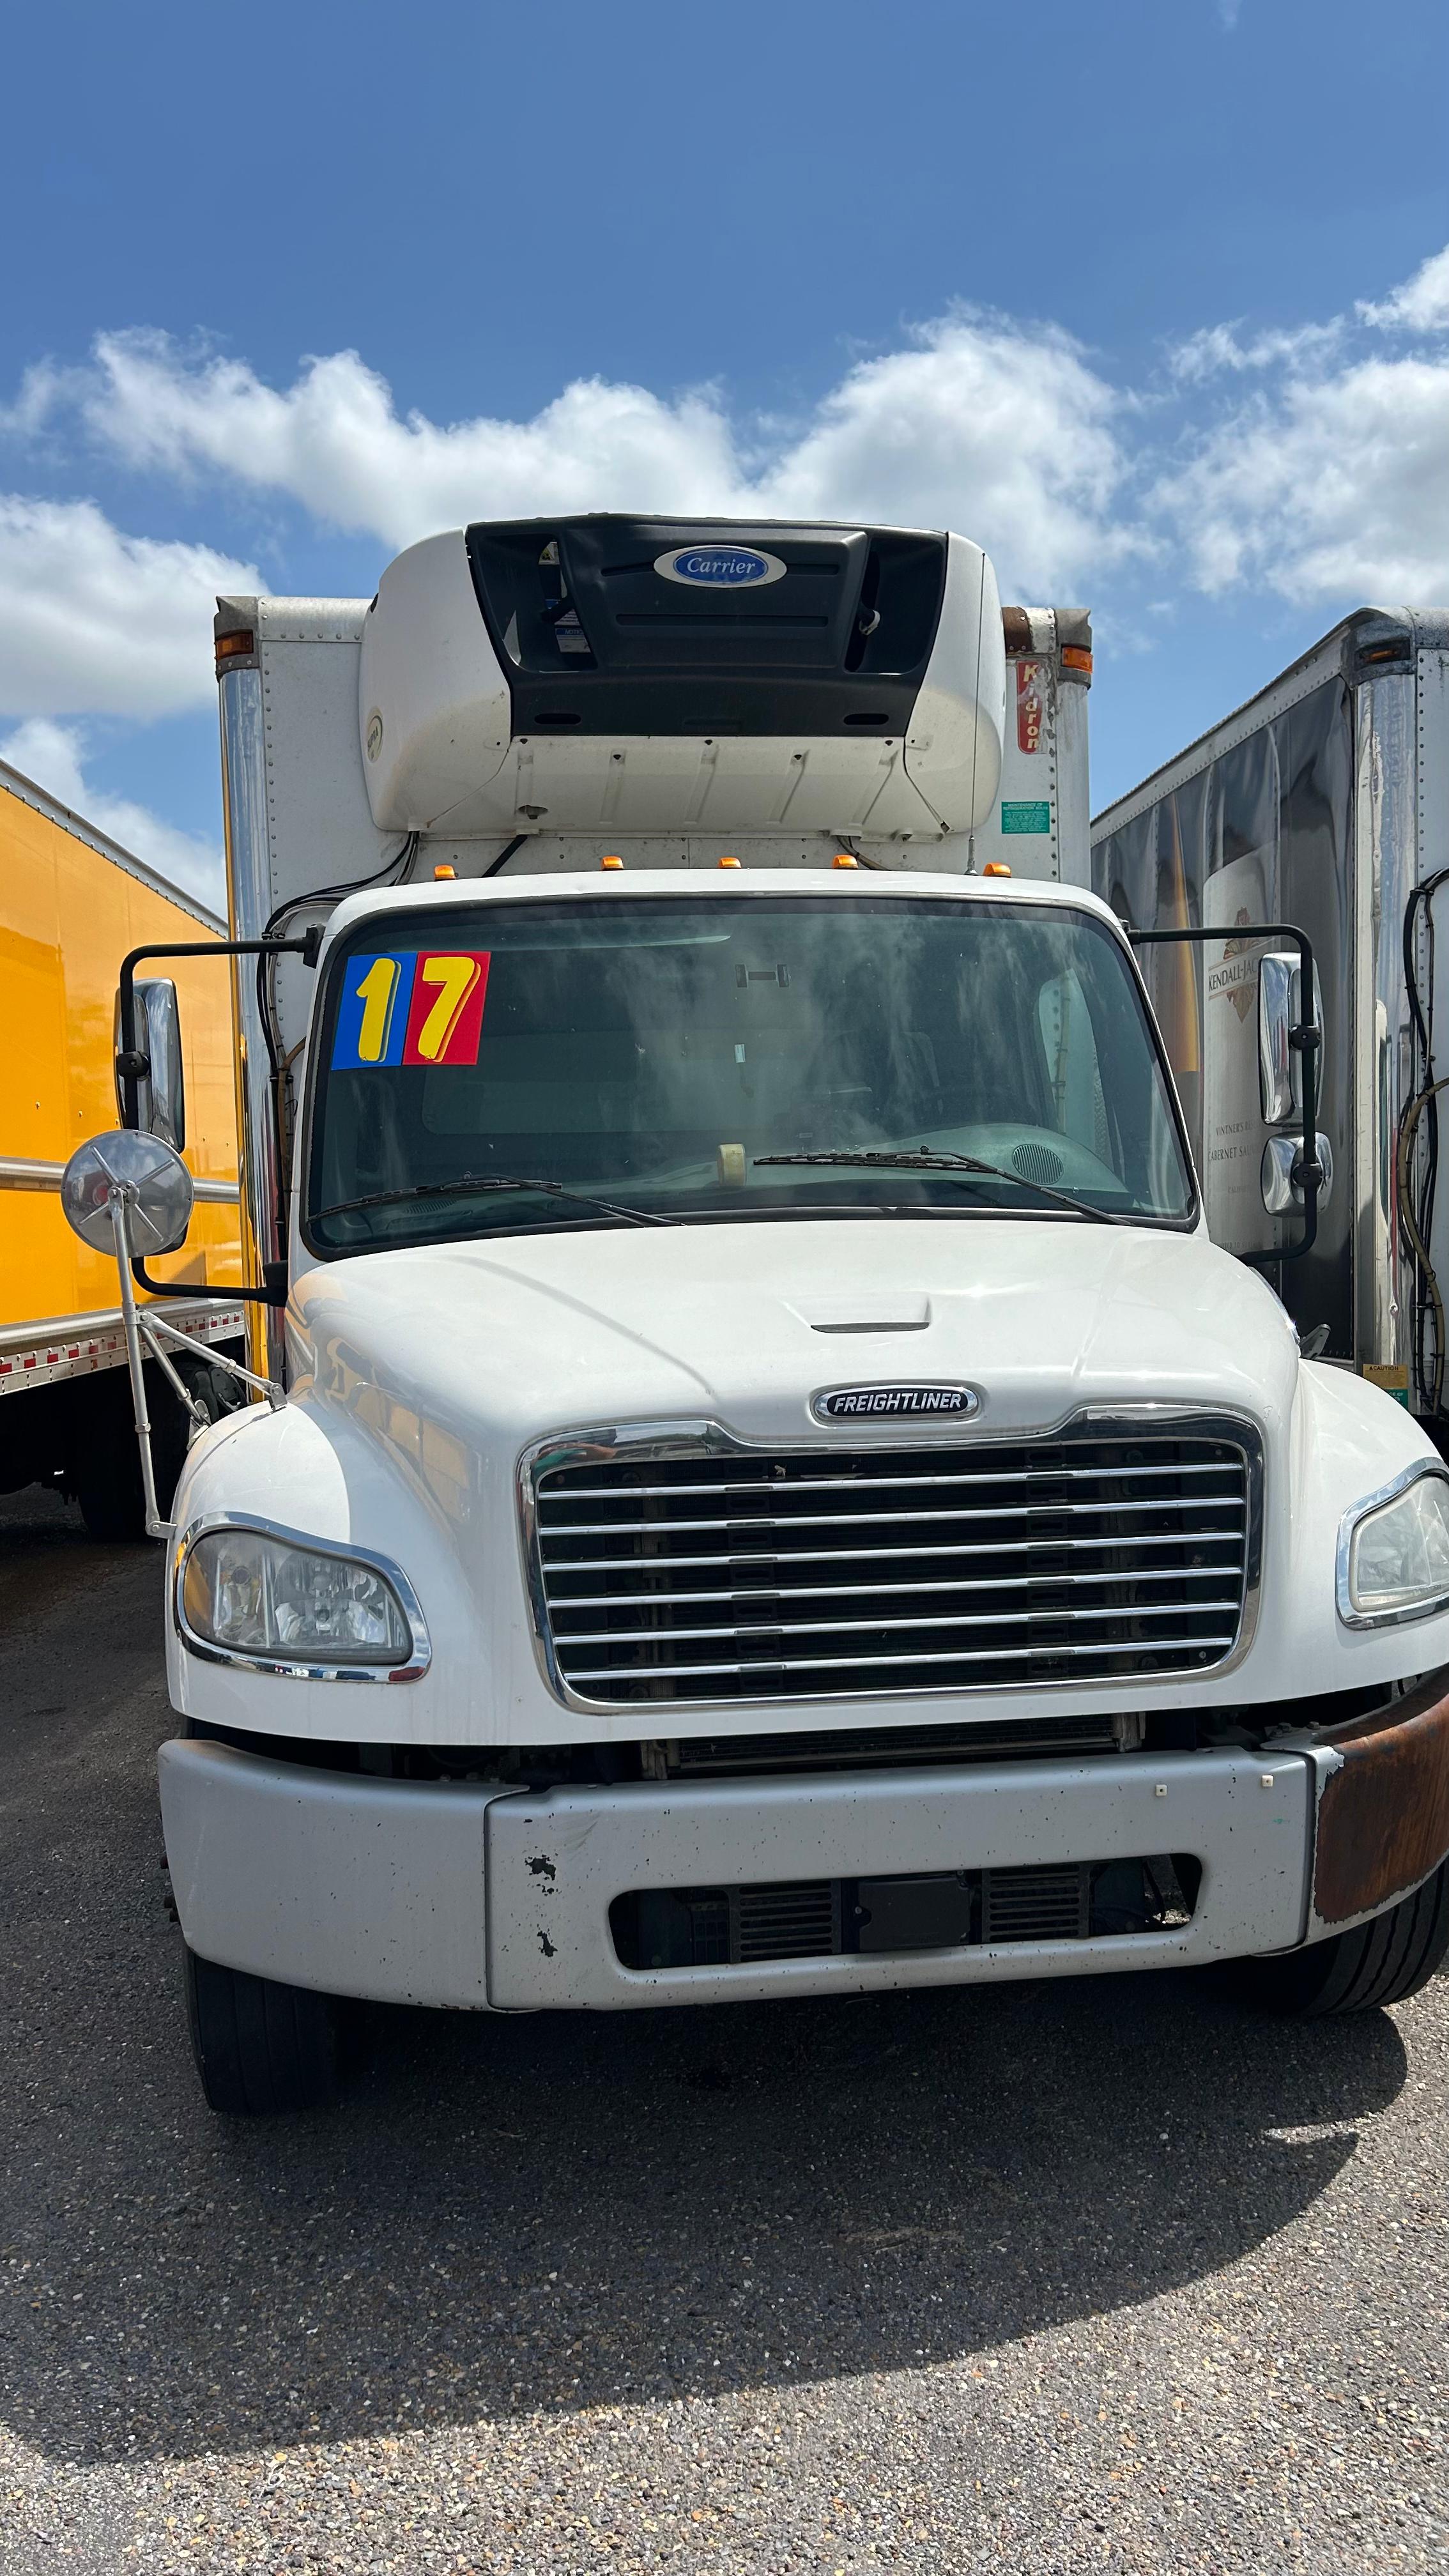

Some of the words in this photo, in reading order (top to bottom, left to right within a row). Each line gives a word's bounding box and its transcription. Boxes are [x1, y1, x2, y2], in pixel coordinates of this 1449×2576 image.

[687, 557, 756, 574] Carrier
[356, 956, 481, 1062] 17
[1208, 1147, 1237, 1162] CABERNET
[833, 1393, 962, 1413] FREIGHTLINER
